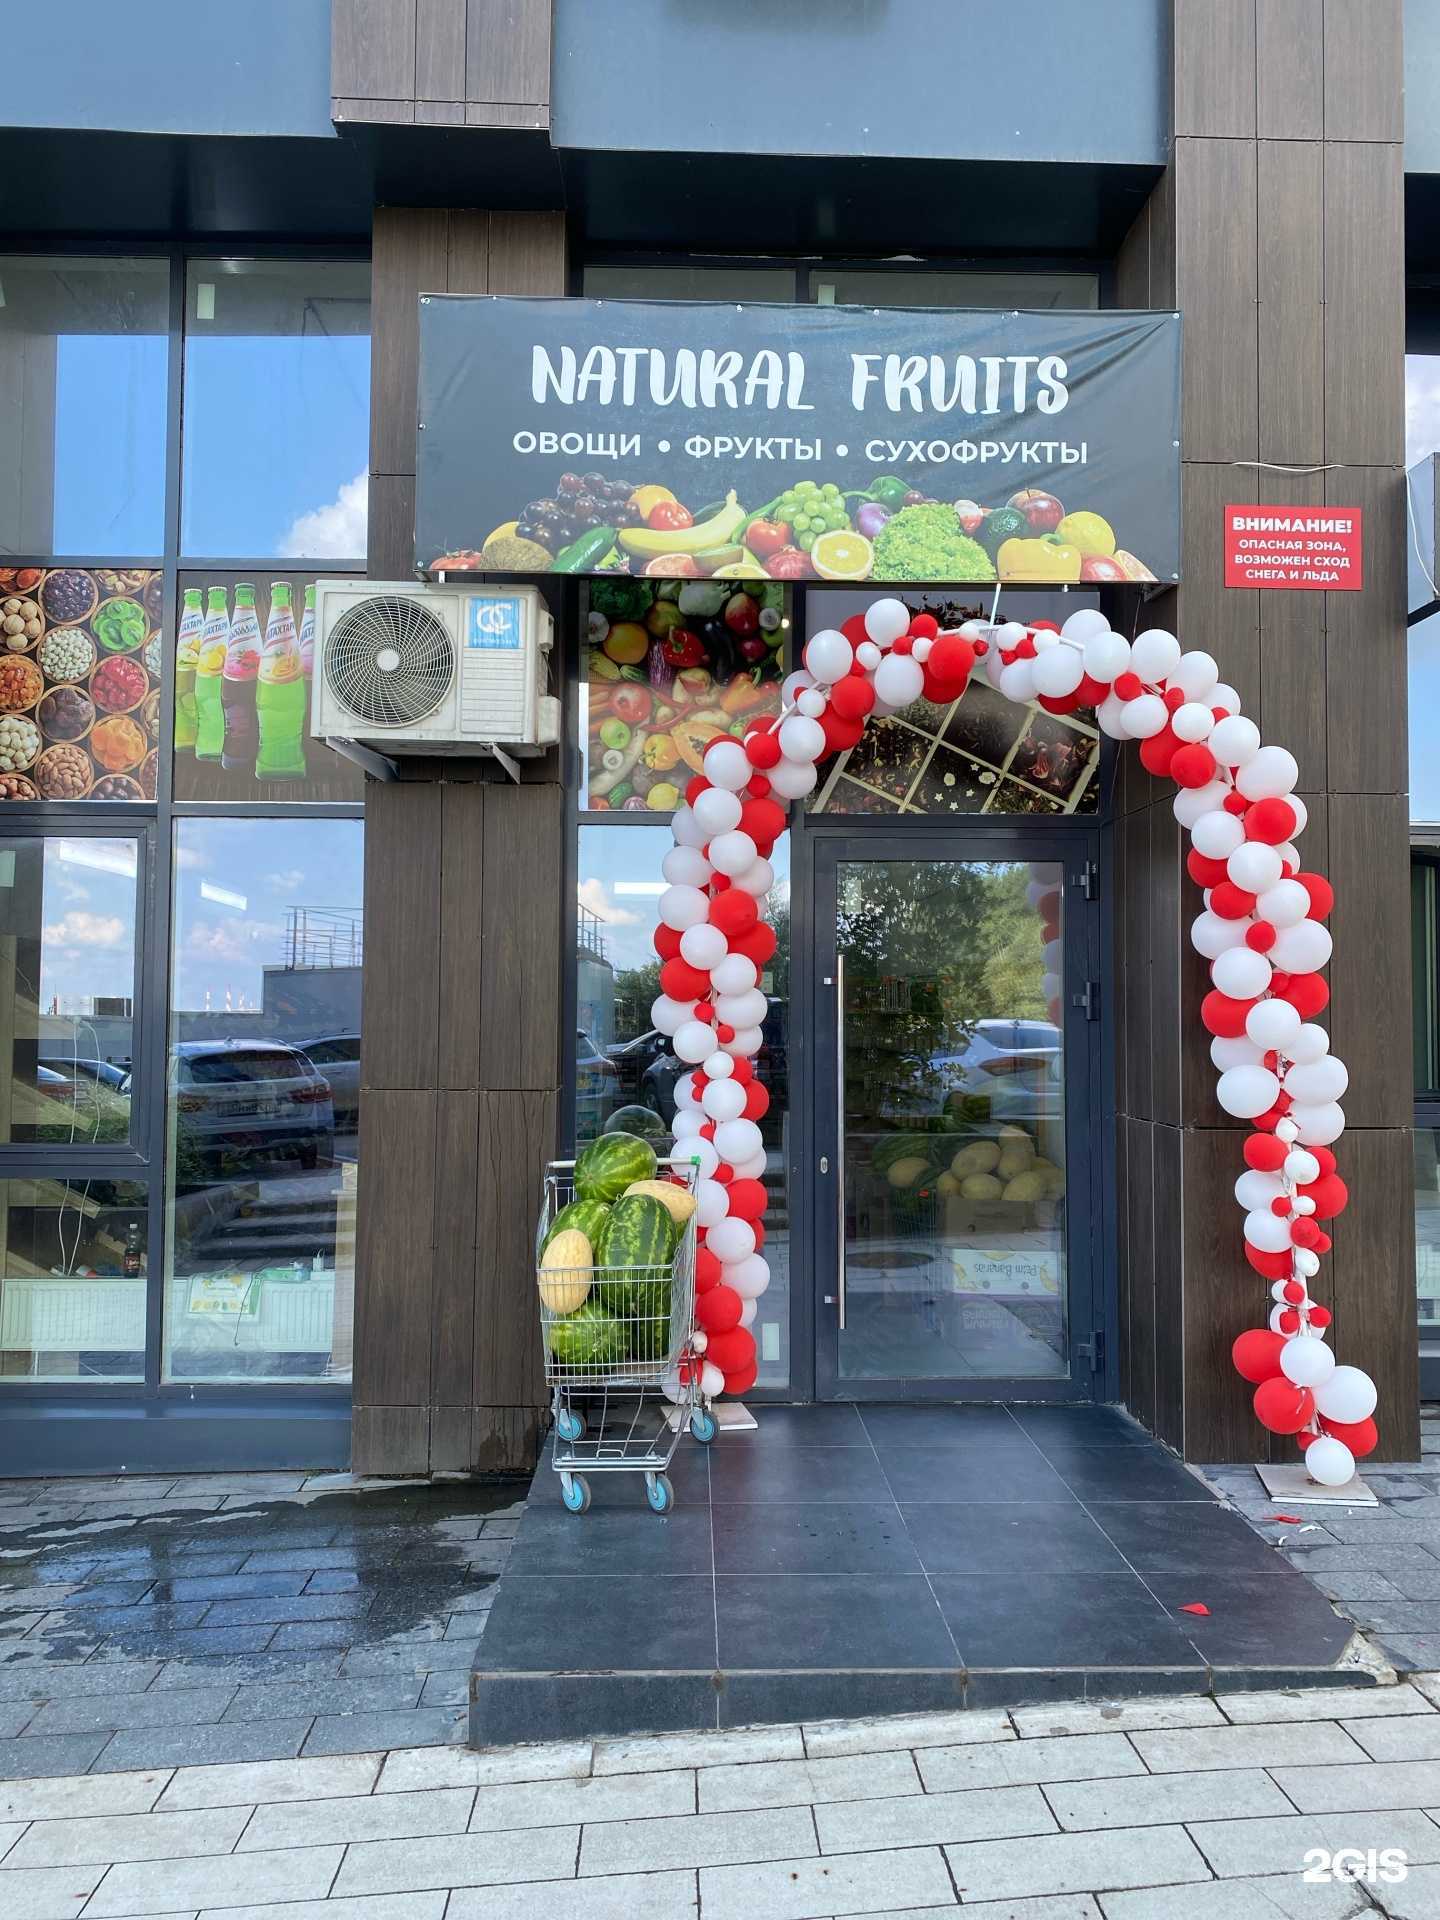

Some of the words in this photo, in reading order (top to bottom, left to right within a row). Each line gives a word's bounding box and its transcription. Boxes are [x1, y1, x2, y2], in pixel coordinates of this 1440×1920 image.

[531, 345, 815, 411] NATURAL
[850, 353, 1070, 416] FRUITS
[512, 430, 642, 460] ОВОЩИ
[684, 434, 823, 462] ФРУКТЫ
[864, 439, 1088, 465] СУХОФРУКТЫ
[1232, 516, 1353, 534] ВНИМАНИЕ!
[1239, 539, 1303, 551] ОПАСНАЯ
[1306, 541, 1347, 553] ЗОНА,
[1234, 554, 1311, 566] ВОЗМОЖЕН
[1314, 556, 1351, 569] СХОД
[1245, 569, 1287, 580] СНЕГА
[1289, 570, 1299, 580] И
[1302, 571, 1340, 583] ЛЬДА
